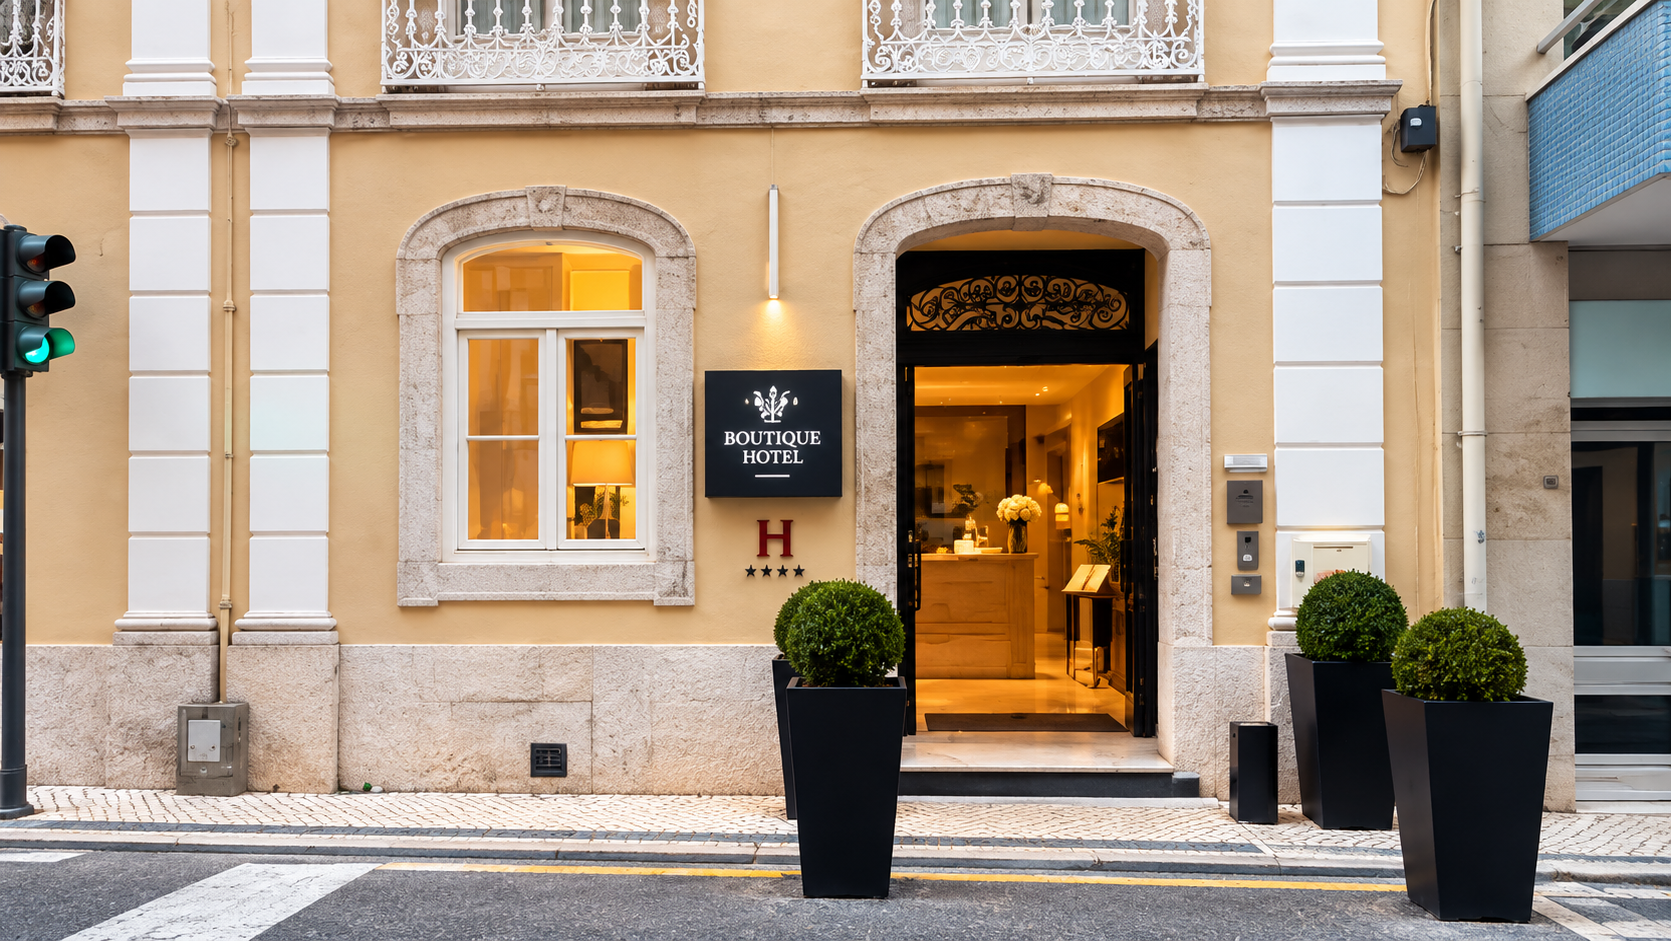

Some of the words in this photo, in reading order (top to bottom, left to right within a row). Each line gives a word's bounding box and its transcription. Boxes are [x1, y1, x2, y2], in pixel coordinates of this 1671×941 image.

[724, 431, 821, 448] BOUTIQUE
[743, 450, 804, 465] HOTEL
[757, 519, 793, 557] H
